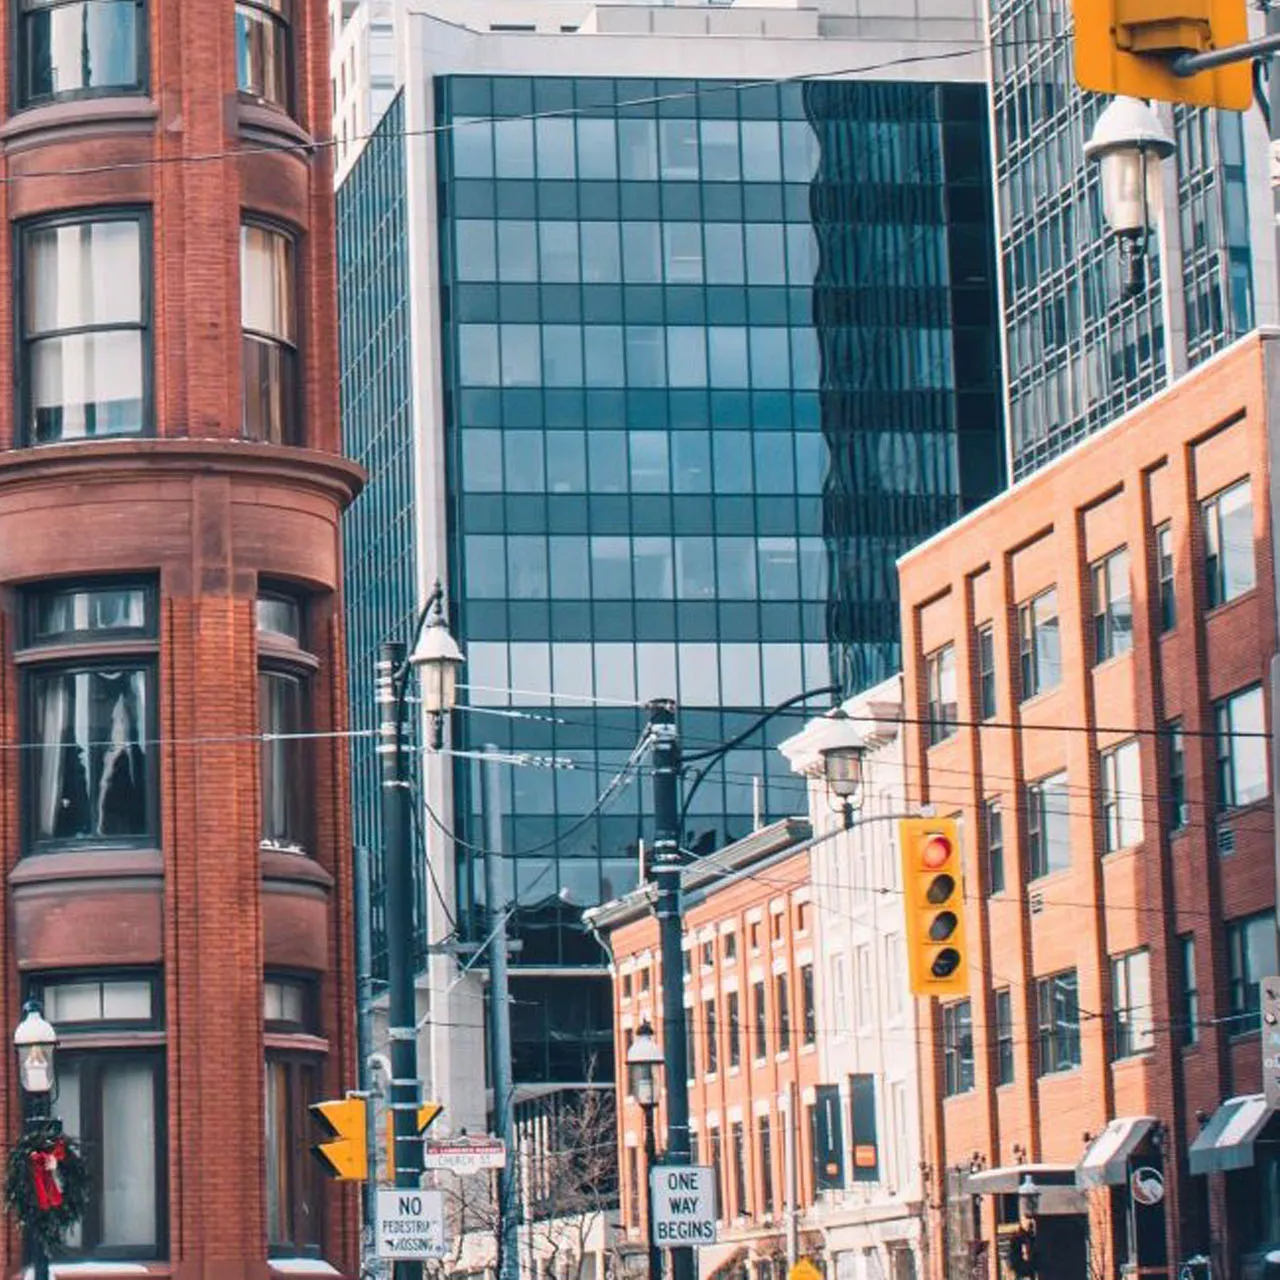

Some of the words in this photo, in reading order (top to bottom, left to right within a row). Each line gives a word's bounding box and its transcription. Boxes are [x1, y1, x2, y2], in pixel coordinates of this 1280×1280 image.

[439, 1155, 474, 1166] CHURCH
[668, 1173, 699, 1190] ONE
[399, 1197, 422, 1216] NO
[669, 1197, 698, 1214] WAY
[382, 1220, 437, 1233] PEDESTRI
[658, 1220, 713, 1239] BEGINS
